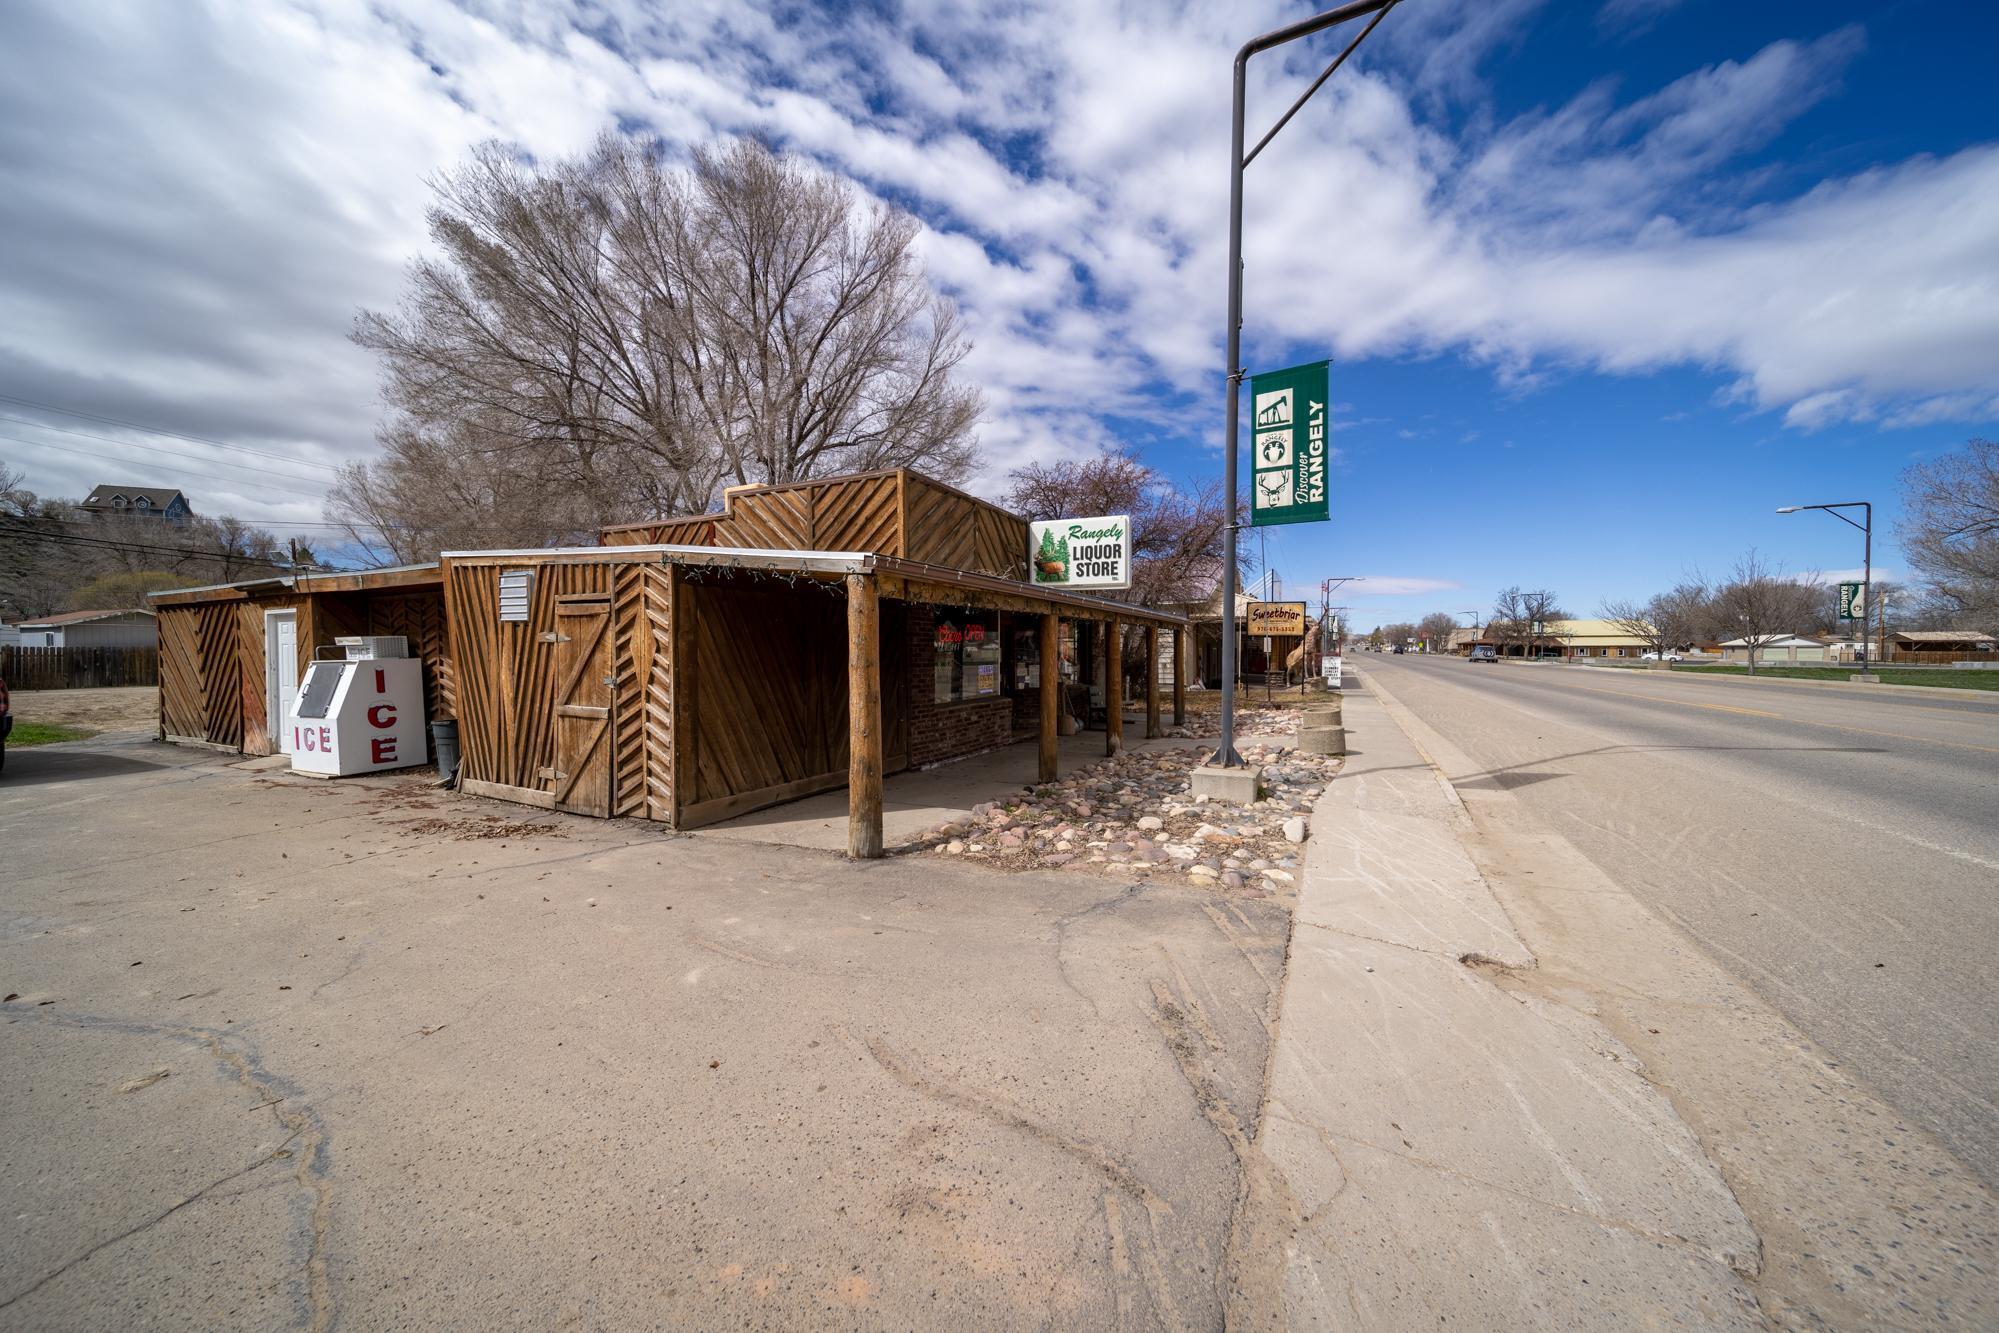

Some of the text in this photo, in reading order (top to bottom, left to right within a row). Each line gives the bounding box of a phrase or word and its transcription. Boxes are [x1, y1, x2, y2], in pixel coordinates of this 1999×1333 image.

[1309, 400, 1324, 503] RANGELY
[1295, 452, 1308, 505] Discover
[1068, 523, 1124, 544] Rangely
[1073, 543, 1122, 562] LIQUOR
[1076, 561, 1118, 578] STORE
[1840, 585, 1848, 617] RANGELY
[1252, 606, 1301, 622] Sweetbriar
[964, 623, 985, 641] OPEN
[367, 669, 398, 764] ICE
[295, 726, 331, 753] ICE
